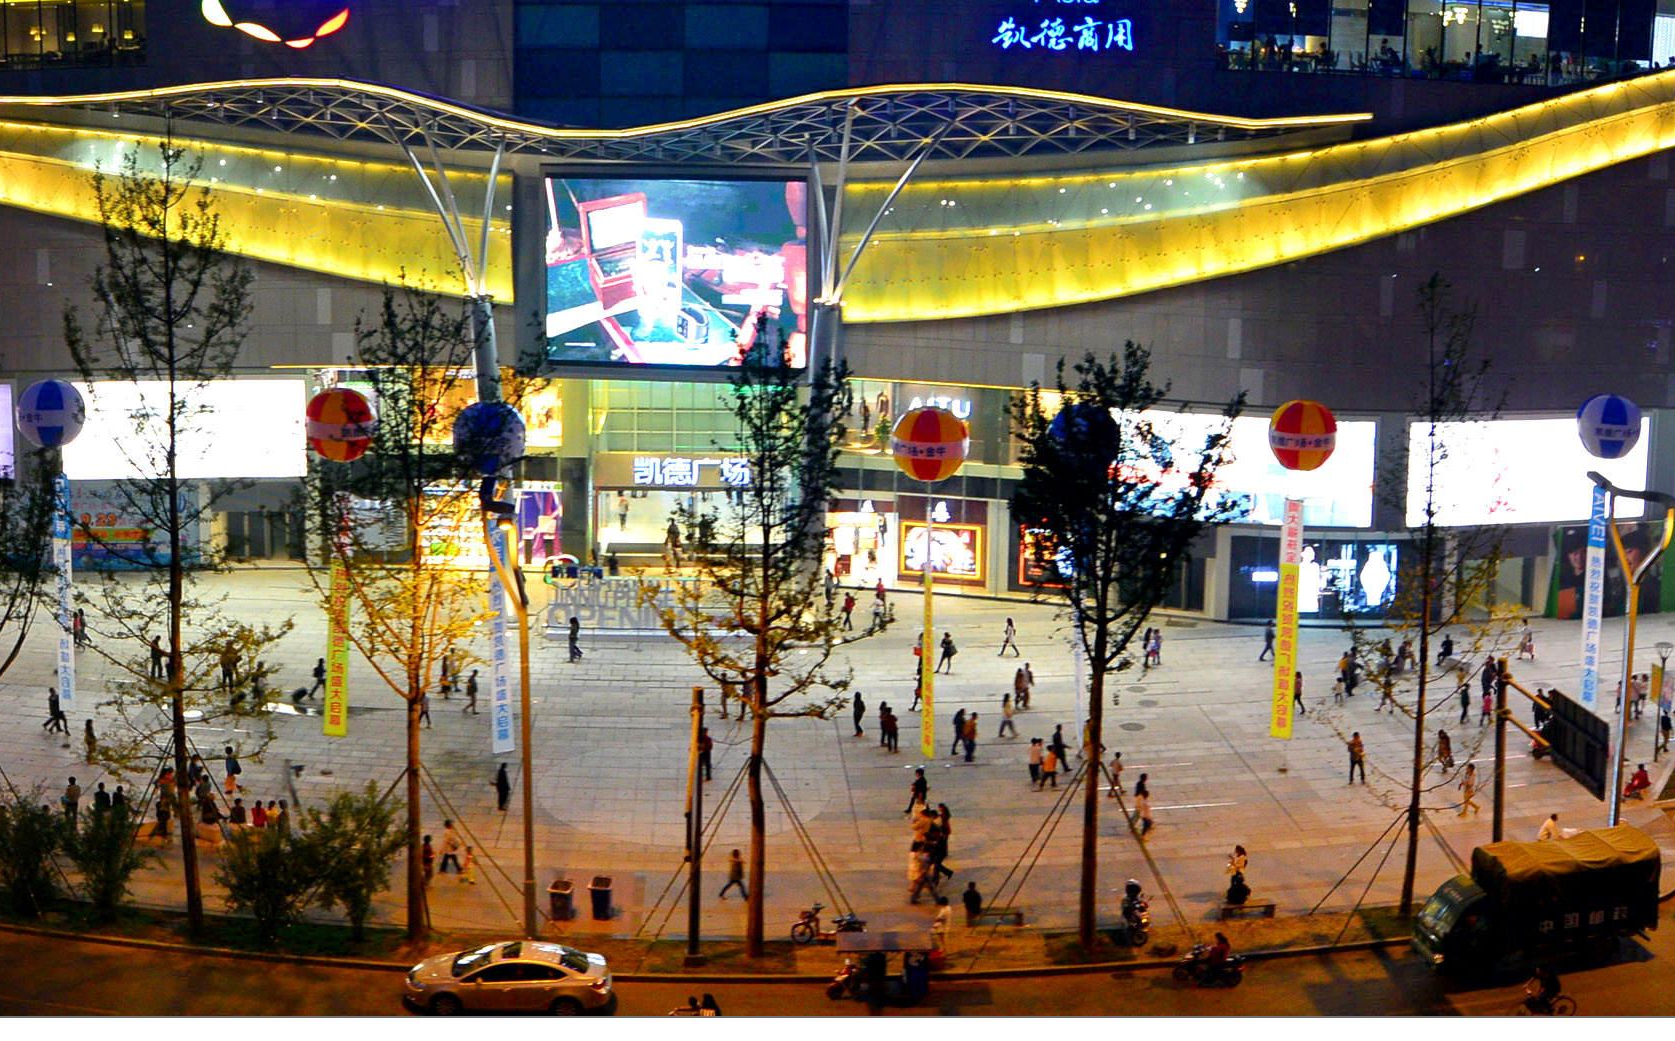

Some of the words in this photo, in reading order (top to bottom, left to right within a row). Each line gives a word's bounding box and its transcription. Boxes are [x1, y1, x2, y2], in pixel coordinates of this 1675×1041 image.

[991, 16, 1134, 52] 凯德商用
[634, 457, 752, 486] 凯德广场
